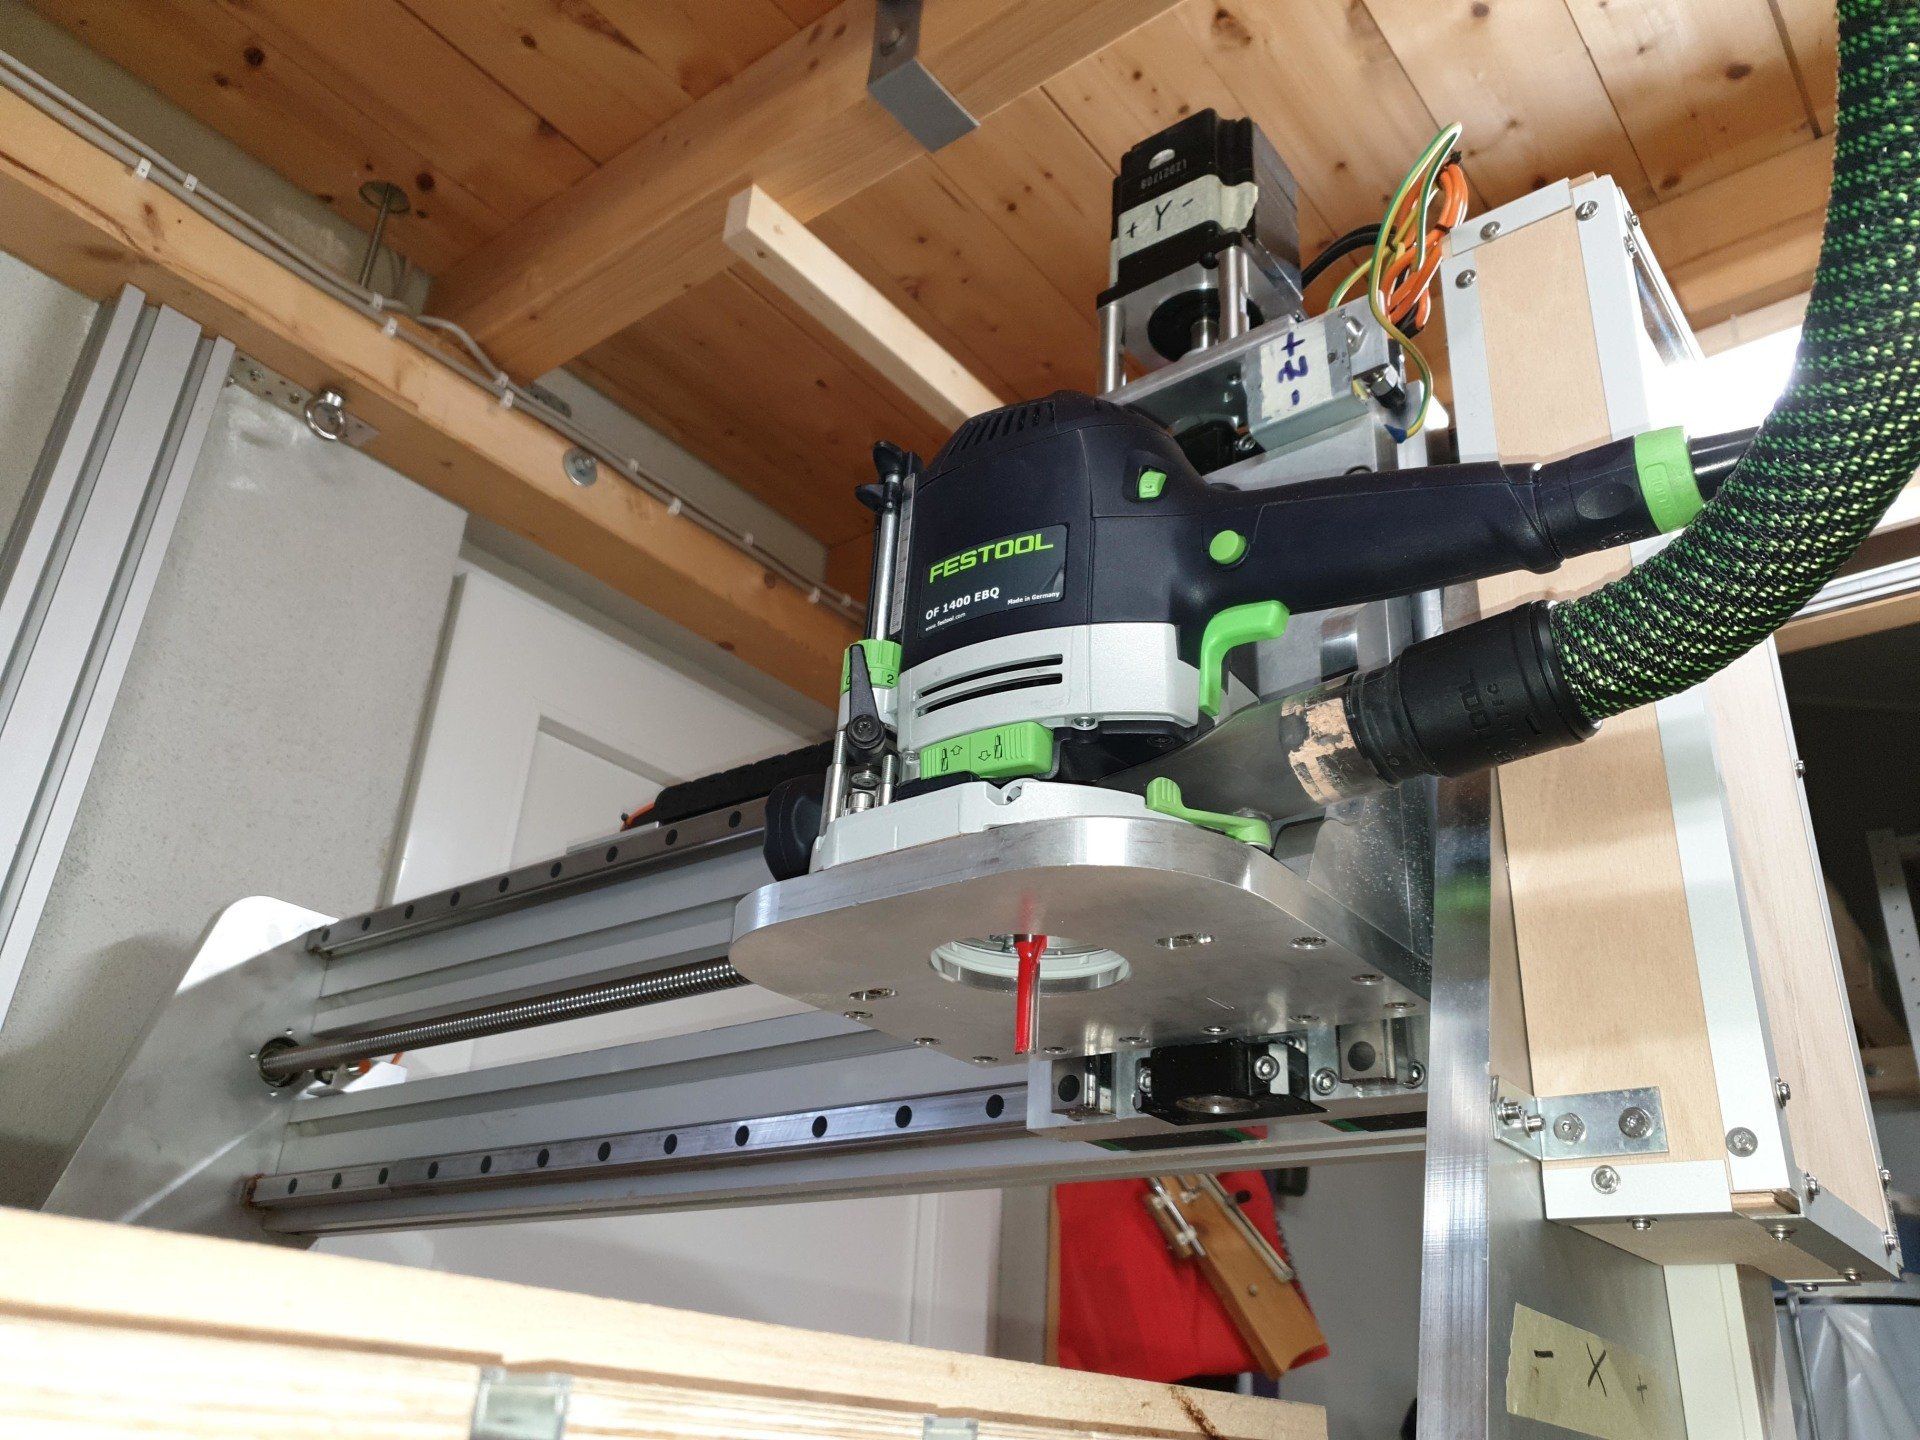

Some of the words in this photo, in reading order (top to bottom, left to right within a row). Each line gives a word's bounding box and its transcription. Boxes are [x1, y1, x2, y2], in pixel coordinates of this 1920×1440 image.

[1154, 200, 1175, 231] Y
[929, 533, 1054, 583] FESTOOL
[925, 606, 940, 620] OF
[943, 595, 971, 613] 1400
[974, 586, 1000, 602] EBQ
[1007, 597, 1024, 605] Made
[1031, 591, 1060, 600] Germany
[886, 674, 895, 685] 2
[1586, 1342, 1608, 1397] X
